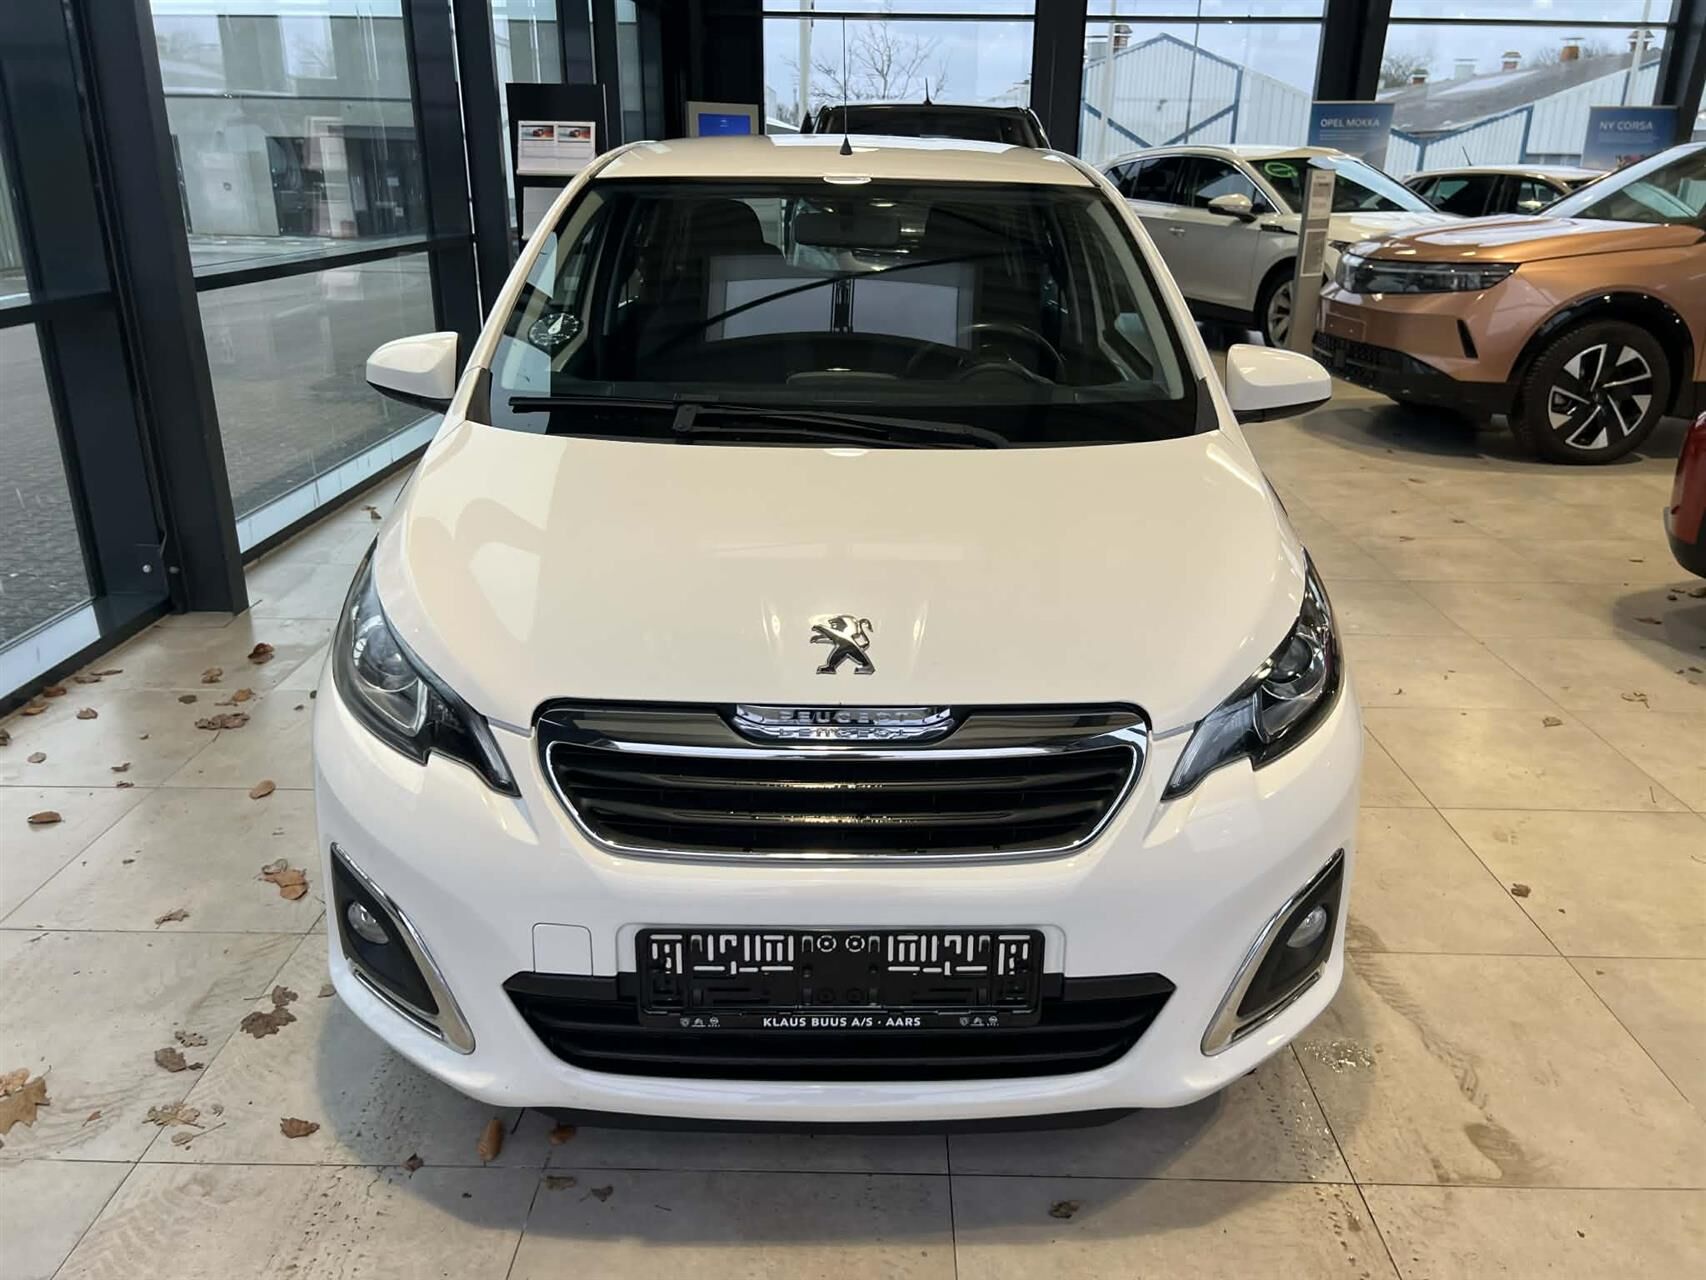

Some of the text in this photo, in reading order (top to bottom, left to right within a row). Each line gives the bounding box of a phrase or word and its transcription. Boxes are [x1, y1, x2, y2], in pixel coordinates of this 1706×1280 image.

[1320, 118, 1380, 128] OPEL MOKKA
[1600, 120, 1653, 131] NY CORSA
[763, 1017, 921, 1027] KLAUS BUUS A/S AARS
